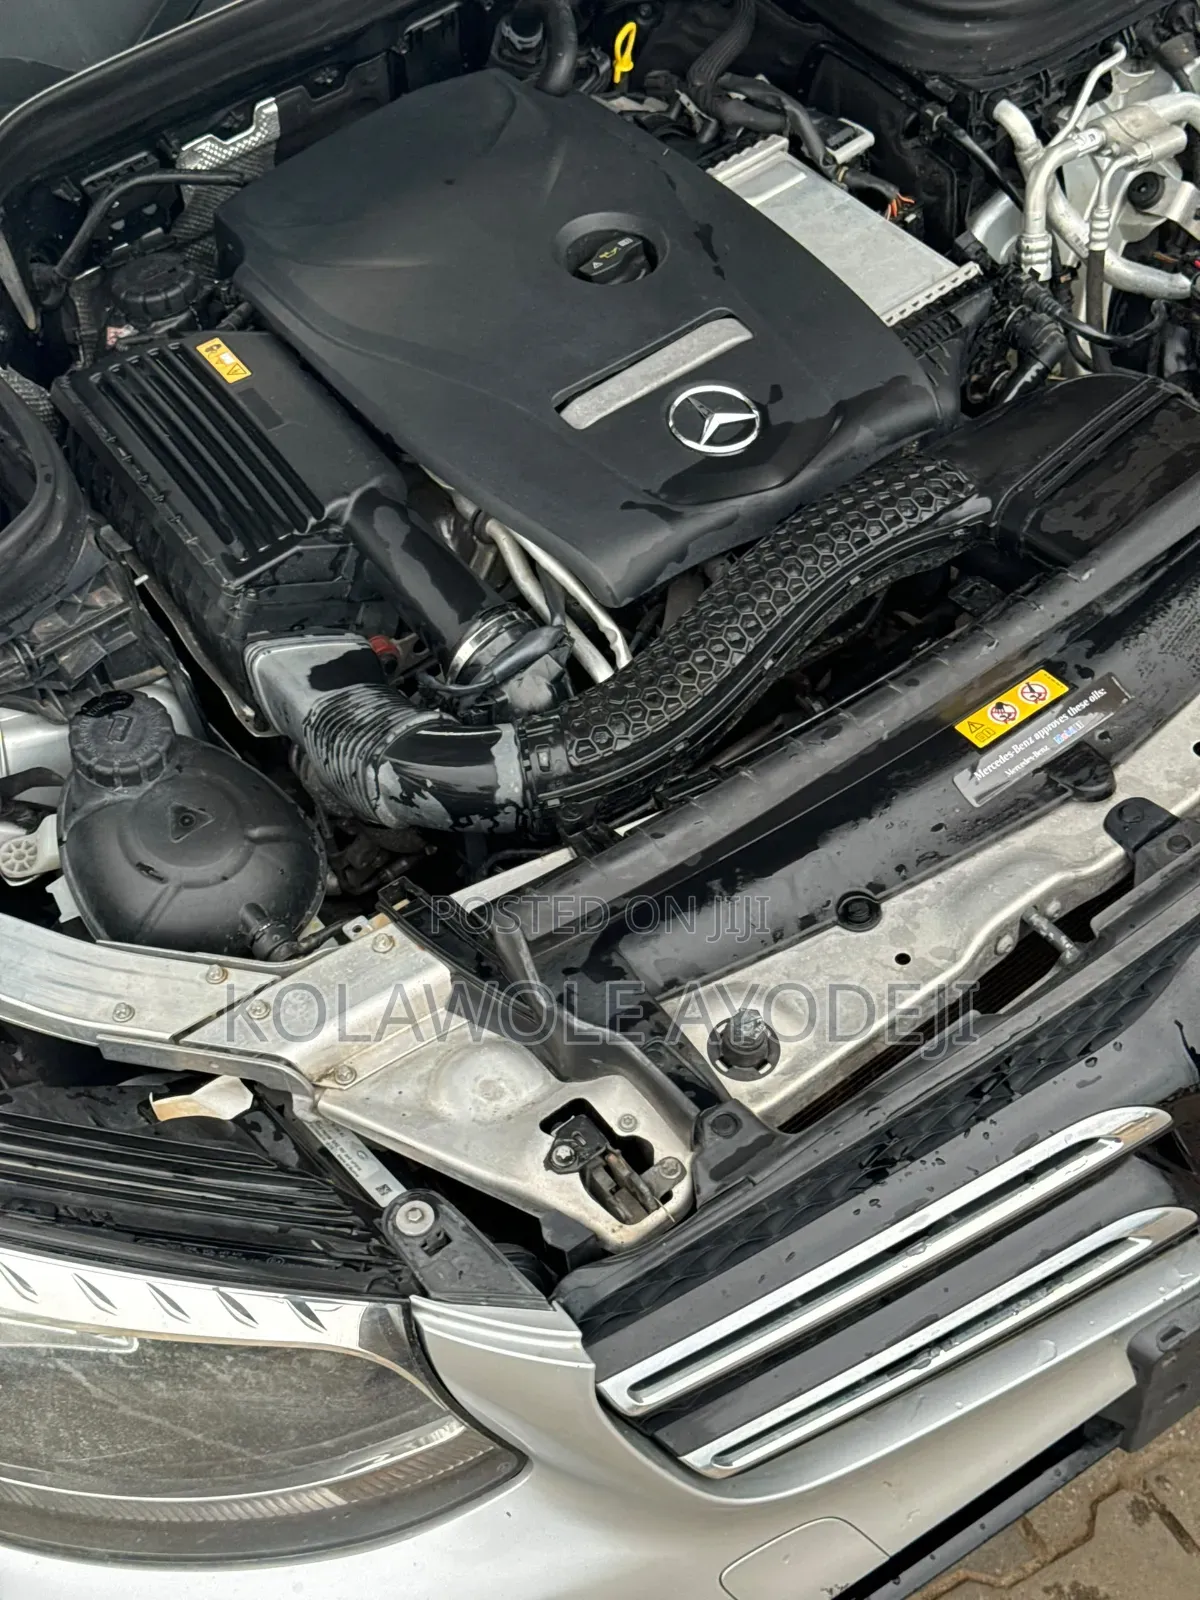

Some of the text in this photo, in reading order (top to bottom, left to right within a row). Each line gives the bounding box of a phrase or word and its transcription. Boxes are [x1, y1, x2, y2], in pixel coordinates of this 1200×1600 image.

[973, 687, 1107, 780] Mercedes-Benz approves these oils:
